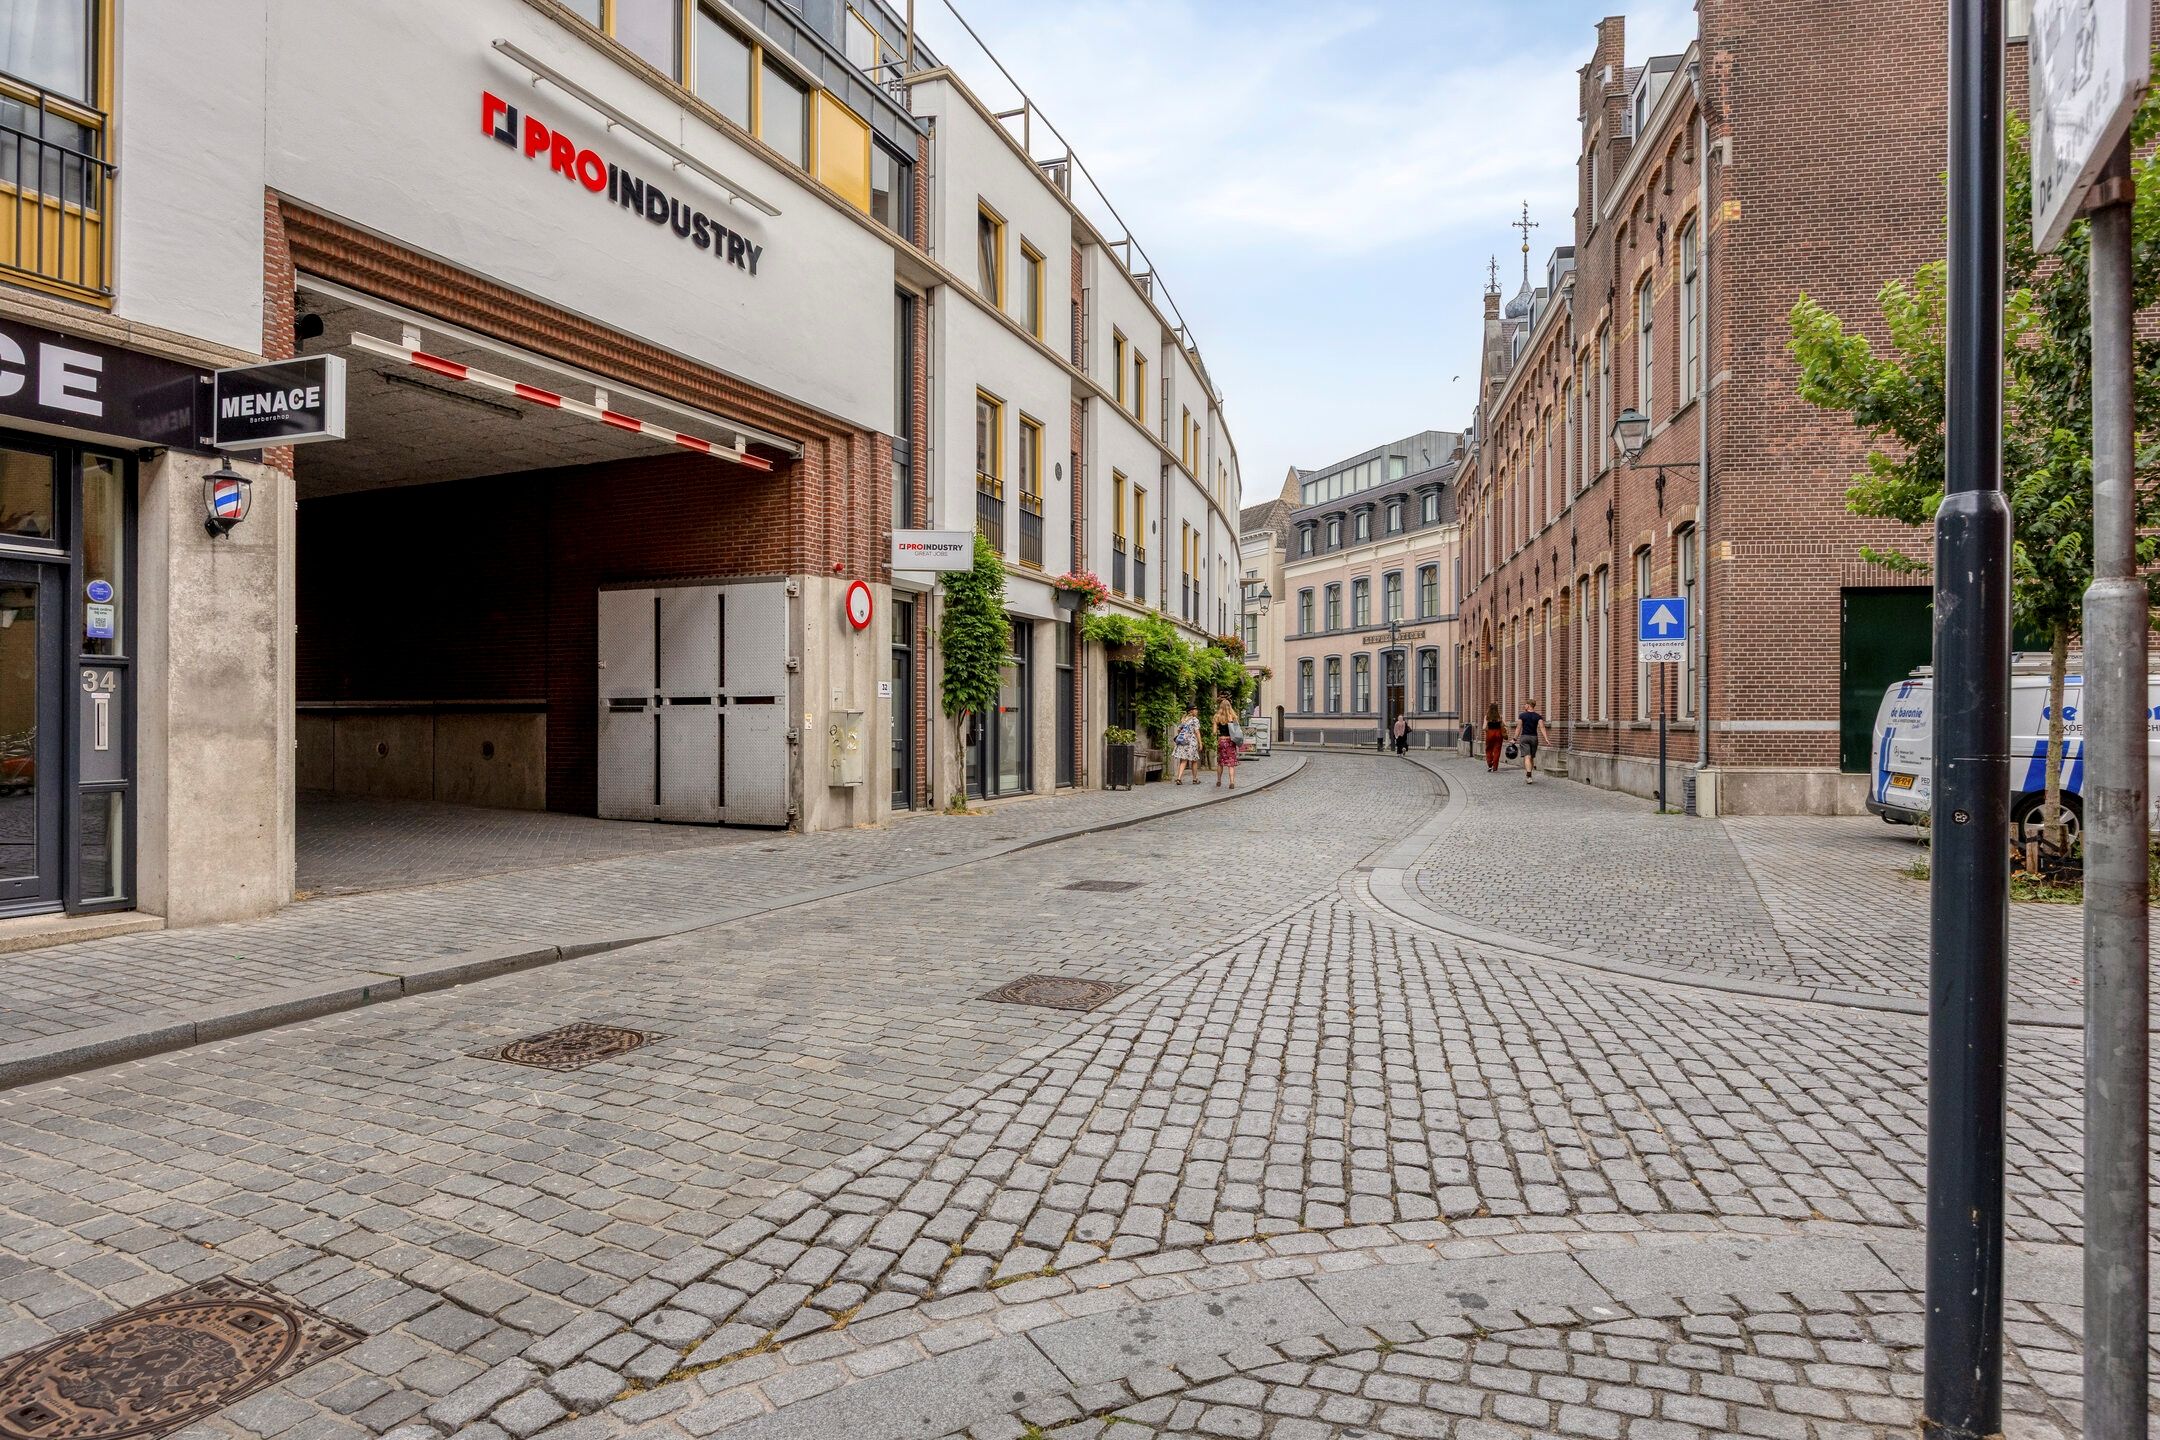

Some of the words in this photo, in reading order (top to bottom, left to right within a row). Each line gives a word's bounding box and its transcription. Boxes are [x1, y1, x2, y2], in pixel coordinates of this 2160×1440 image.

[524, 114, 764, 276] PROINDUSTRY
[221, 386, 320, 419] MENACE
[249, 413, 290, 424] Barbershop
[906, 543, 964, 551] PROINDUSTRY
[82, 670, 116, 693] 34
